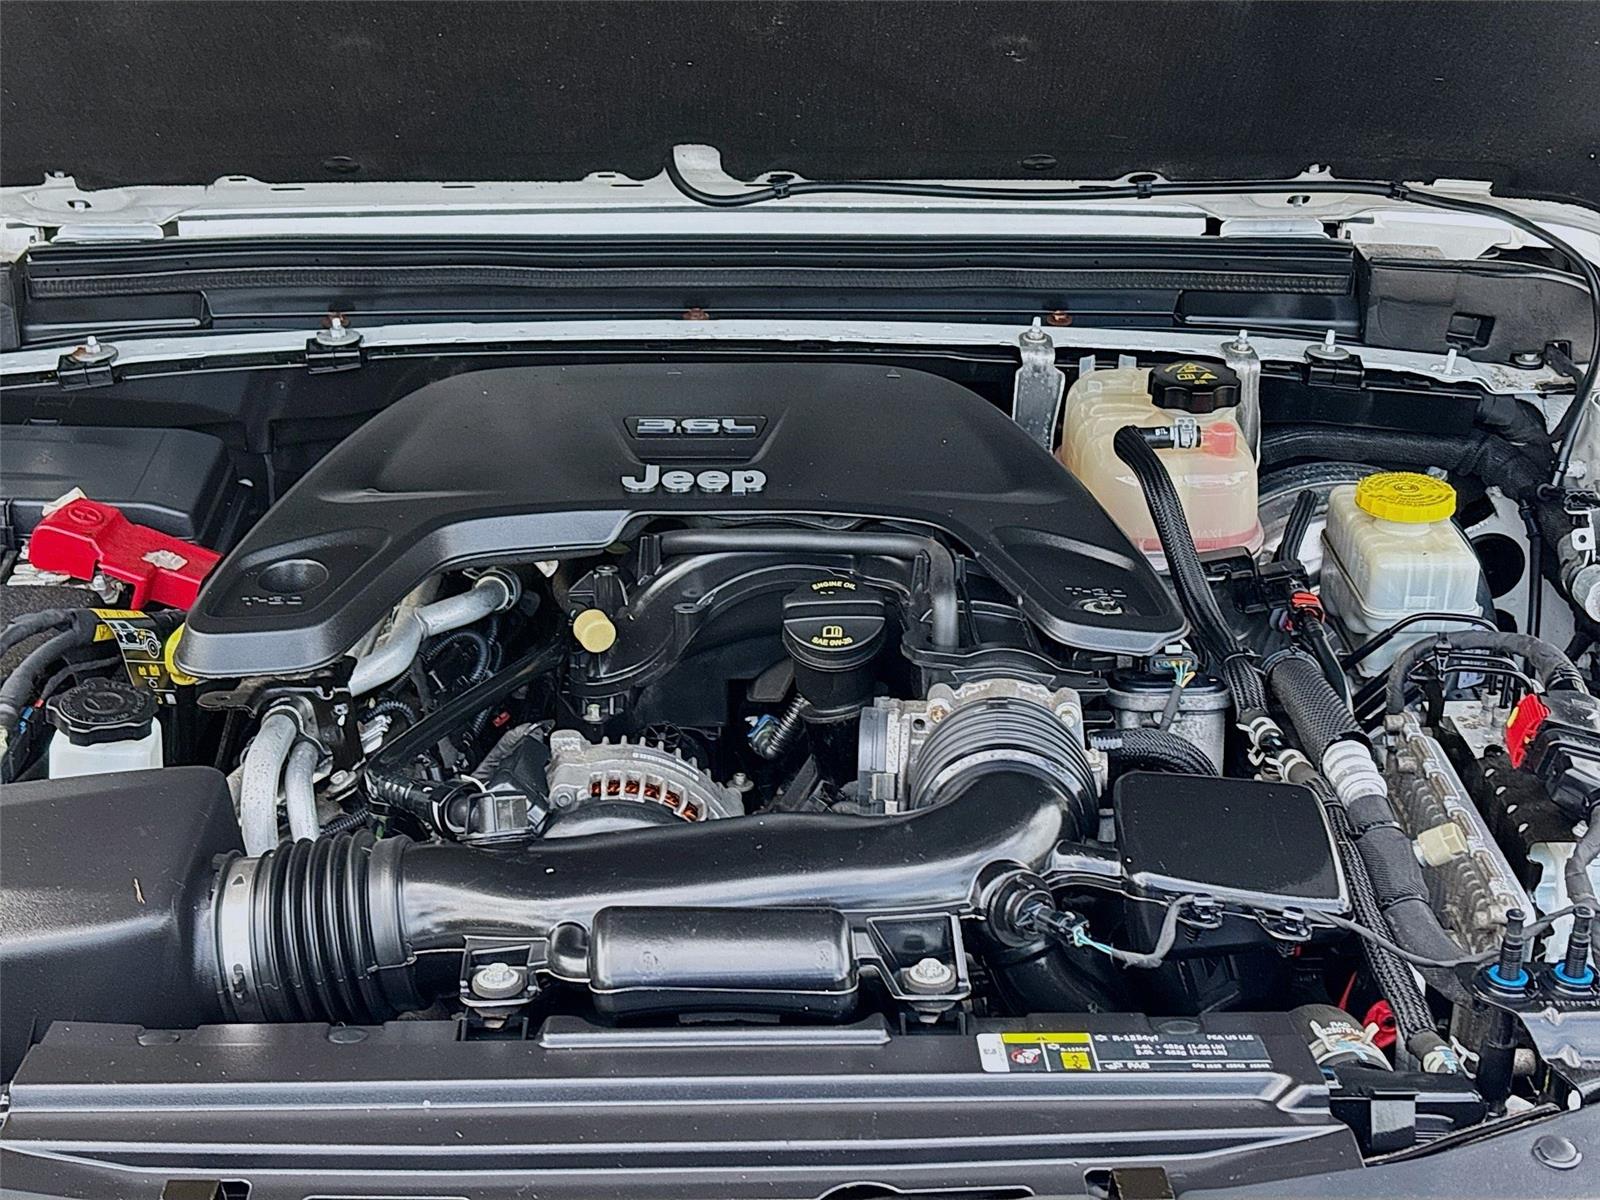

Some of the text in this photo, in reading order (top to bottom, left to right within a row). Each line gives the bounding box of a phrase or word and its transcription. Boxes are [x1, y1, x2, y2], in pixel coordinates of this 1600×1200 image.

[637, 418, 756, 433] 3.6L
[621, 464, 767, 496] Jeep
[811, 581, 856, 590] ENGINE OIL
[811, 636, 828, 646] SAE
